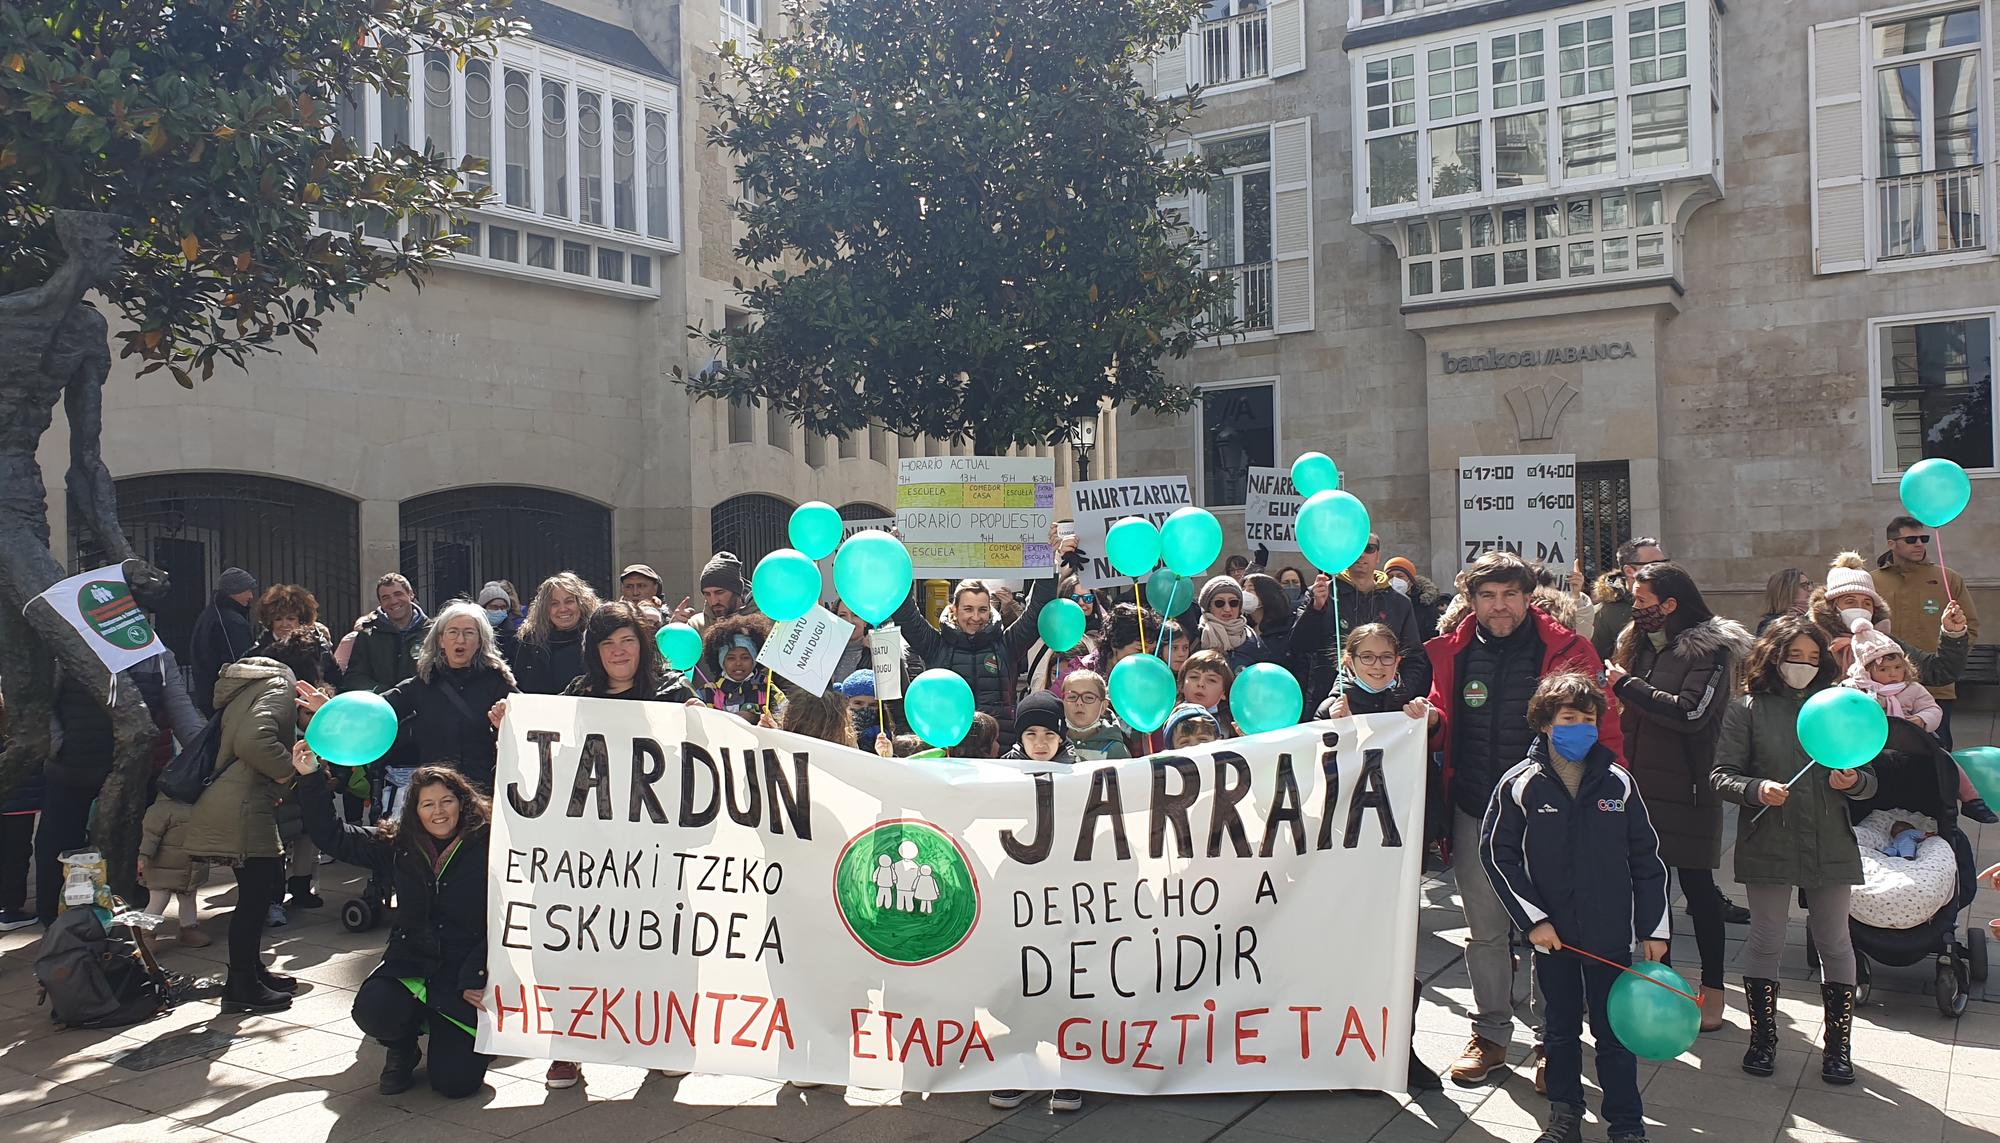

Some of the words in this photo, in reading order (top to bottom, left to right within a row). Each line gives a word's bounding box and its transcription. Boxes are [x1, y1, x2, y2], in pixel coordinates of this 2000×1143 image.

[1442, 347, 1536, 374] bankoa
[950, 458, 990, 470] ACTUAL
[1474, 466, 1514, 480] 17:00
[1538, 464, 1575, 478] 14:00
[907, 488, 946, 496] ESCUELA
[1006, 489, 1033, 497] ESCUELA
[1475, 496, 1514, 511] 15:00
[1538, 494, 1575, 509] 16:00
[1268, 501, 1301, 516] GUK
[897, 512, 962, 529] HORARIO
[970, 513, 1047, 529] PROPUESTO
[912, 547, 955, 556] ESCUELA
[1537, 541, 1564, 563] DA
[783, 617, 808, 655] EZABATU
[797, 644, 813, 670] NAHI
[808, 621, 826, 648] DUGU
[506, 729, 813, 841] JARDUN
[1013, 876, 1220, 928] DERECHO
[1255, 871, 1278, 905] A
[501, 902, 785, 964] ESKUBIDEA
[1021, 923, 1262, 999] DECIDIR
[494, 984, 796, 1051] HEZKUNTZA
[850, 1008, 995, 1068] ETAPA
